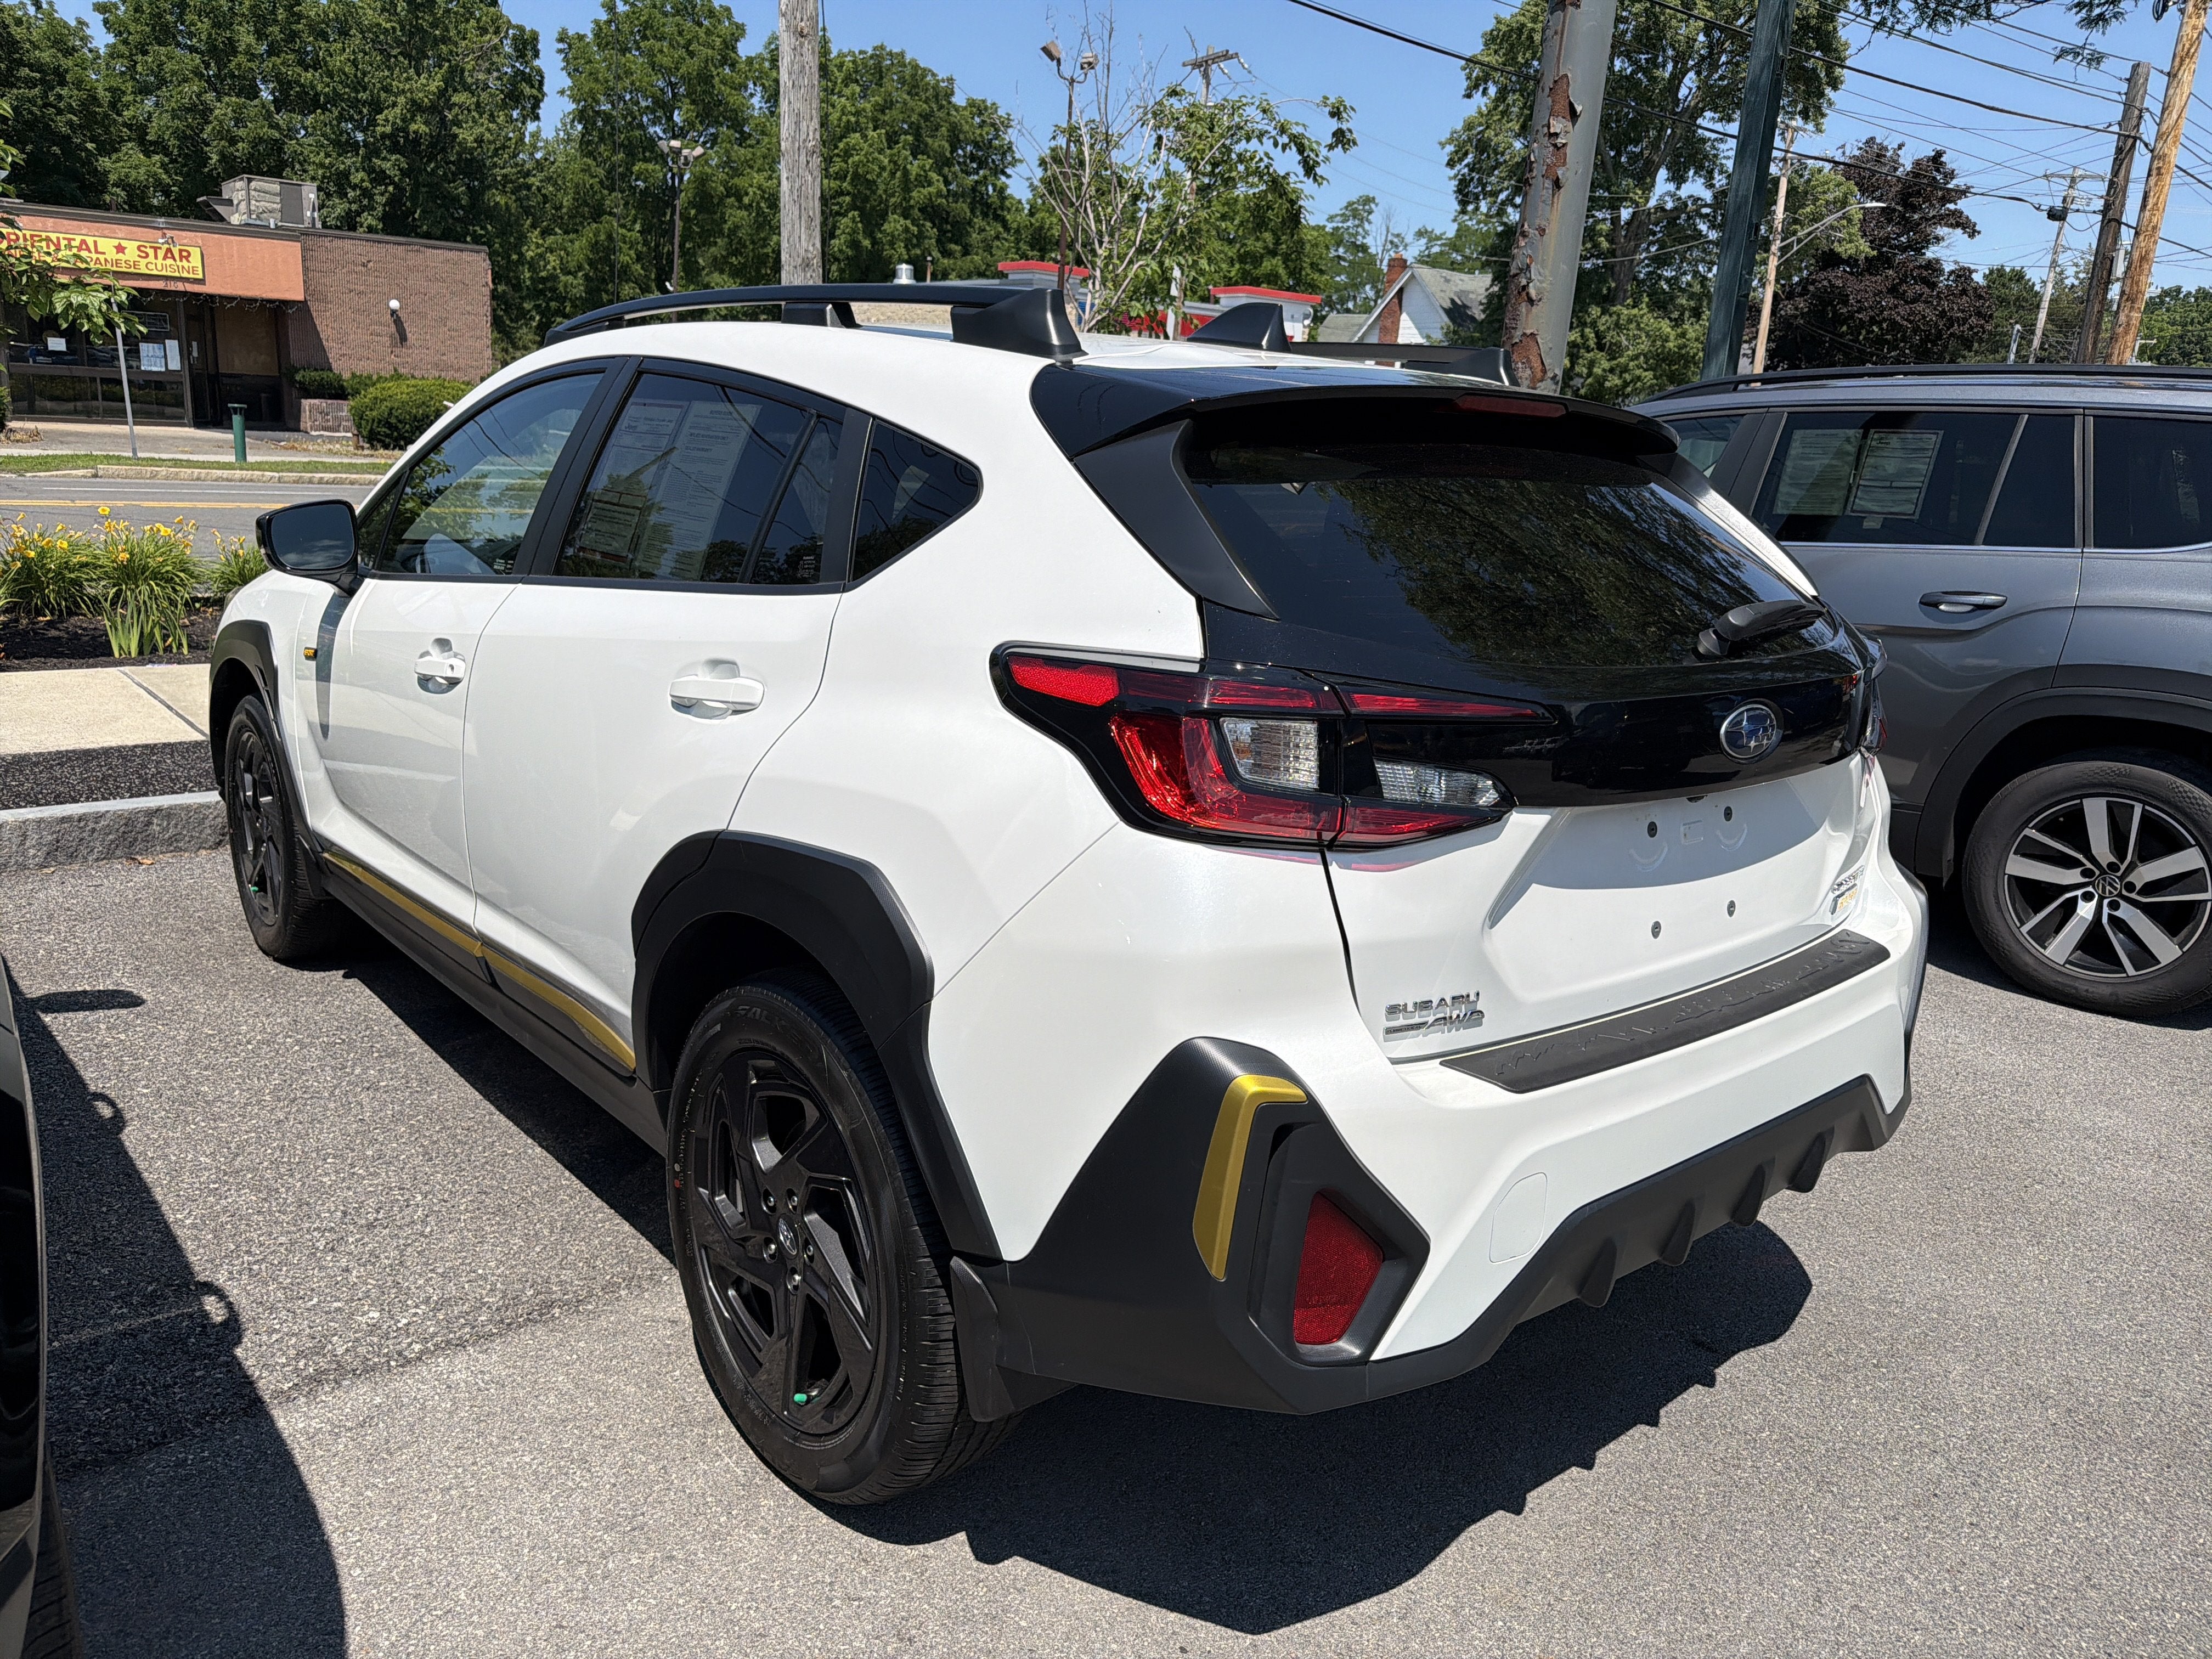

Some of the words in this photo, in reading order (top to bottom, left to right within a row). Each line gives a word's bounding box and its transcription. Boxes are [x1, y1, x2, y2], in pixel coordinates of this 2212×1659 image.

[0, 232, 106, 255] RIENTAL
[137, 244, 191, 263] STAR
[74, 256, 141, 270] APANESE
[145, 261, 200, 275] CUISINE
[1385, 990, 1480, 1015] SUBARU
[1423, 1009, 1485, 1030] AWD
